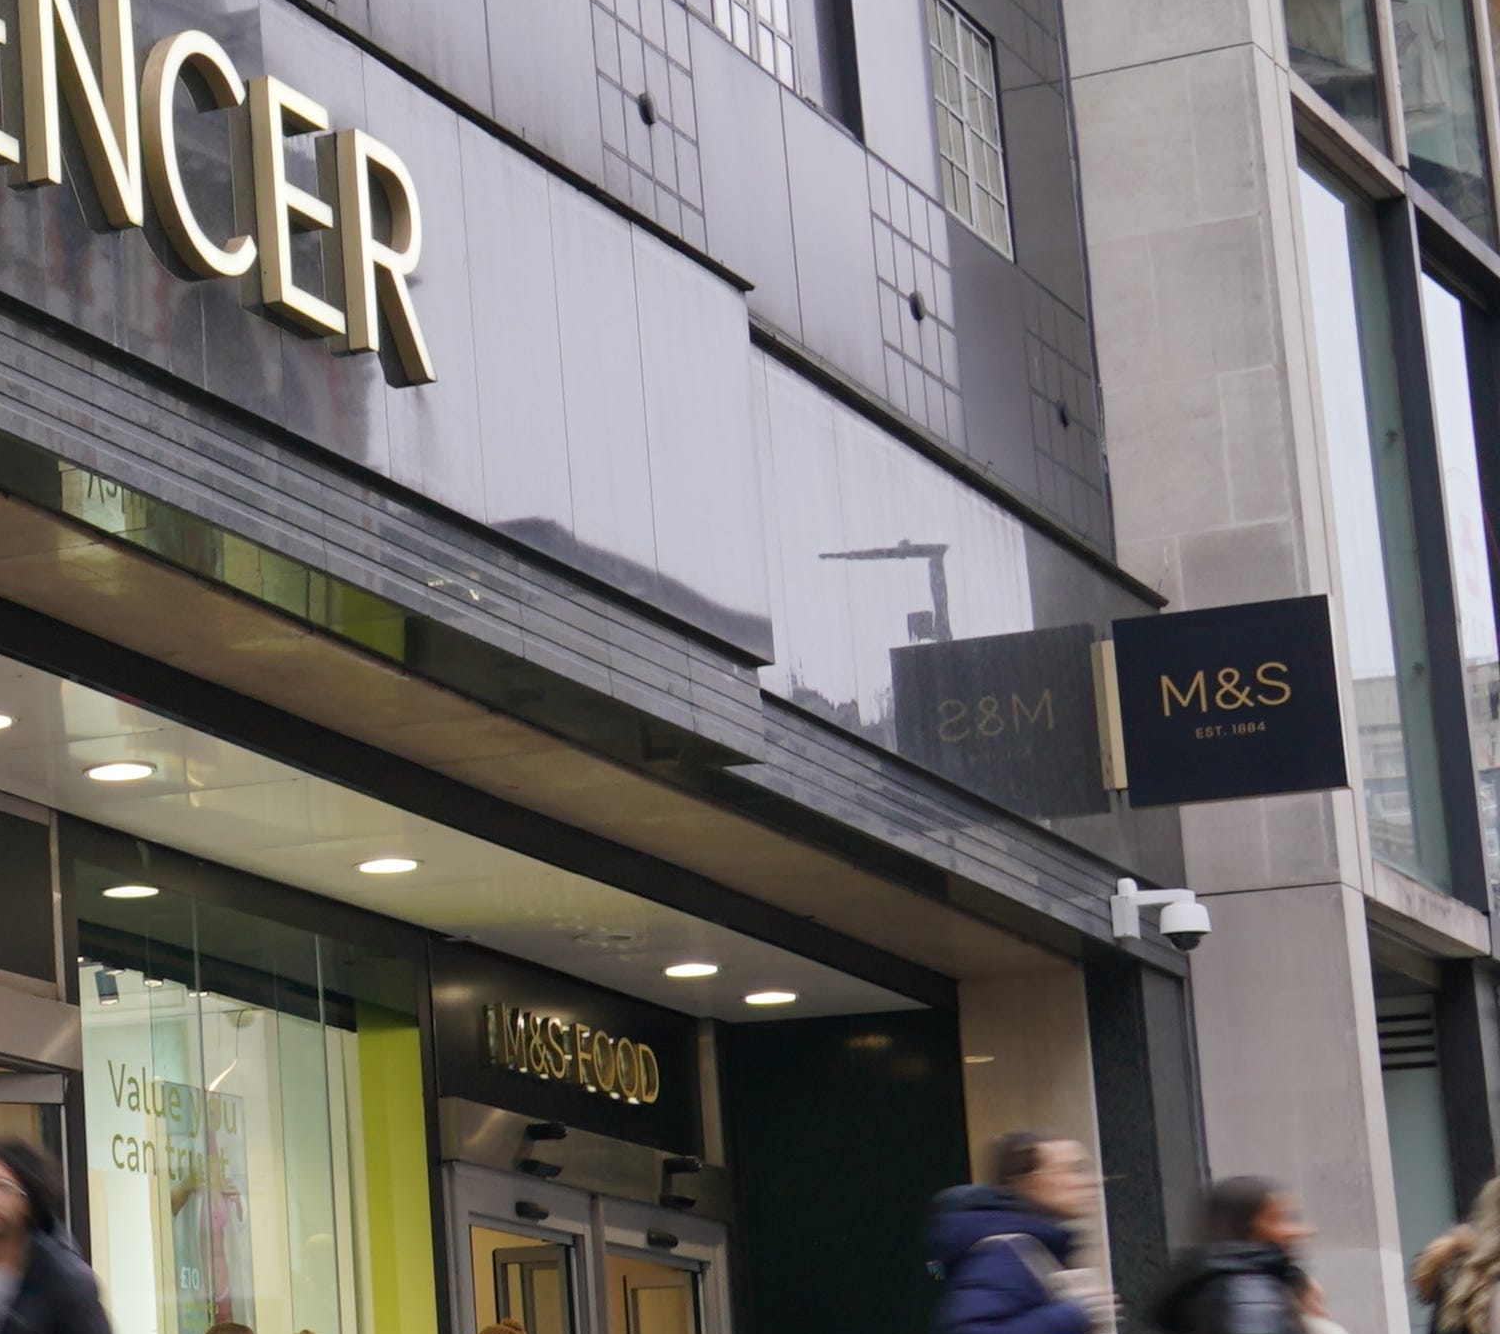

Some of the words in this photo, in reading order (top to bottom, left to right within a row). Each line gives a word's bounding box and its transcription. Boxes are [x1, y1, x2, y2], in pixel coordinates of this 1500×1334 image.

[1160, 661, 1292, 717] M&S
[1232, 720, 1266, 735] 1884
[499, 1002, 568, 1080] M&S
[572, 1022, 660, 1104] FOOD
[107, 1059, 182, 1123] Value
[111, 1133, 158, 1177] can
[180, 1267, 200, 1290] £10
